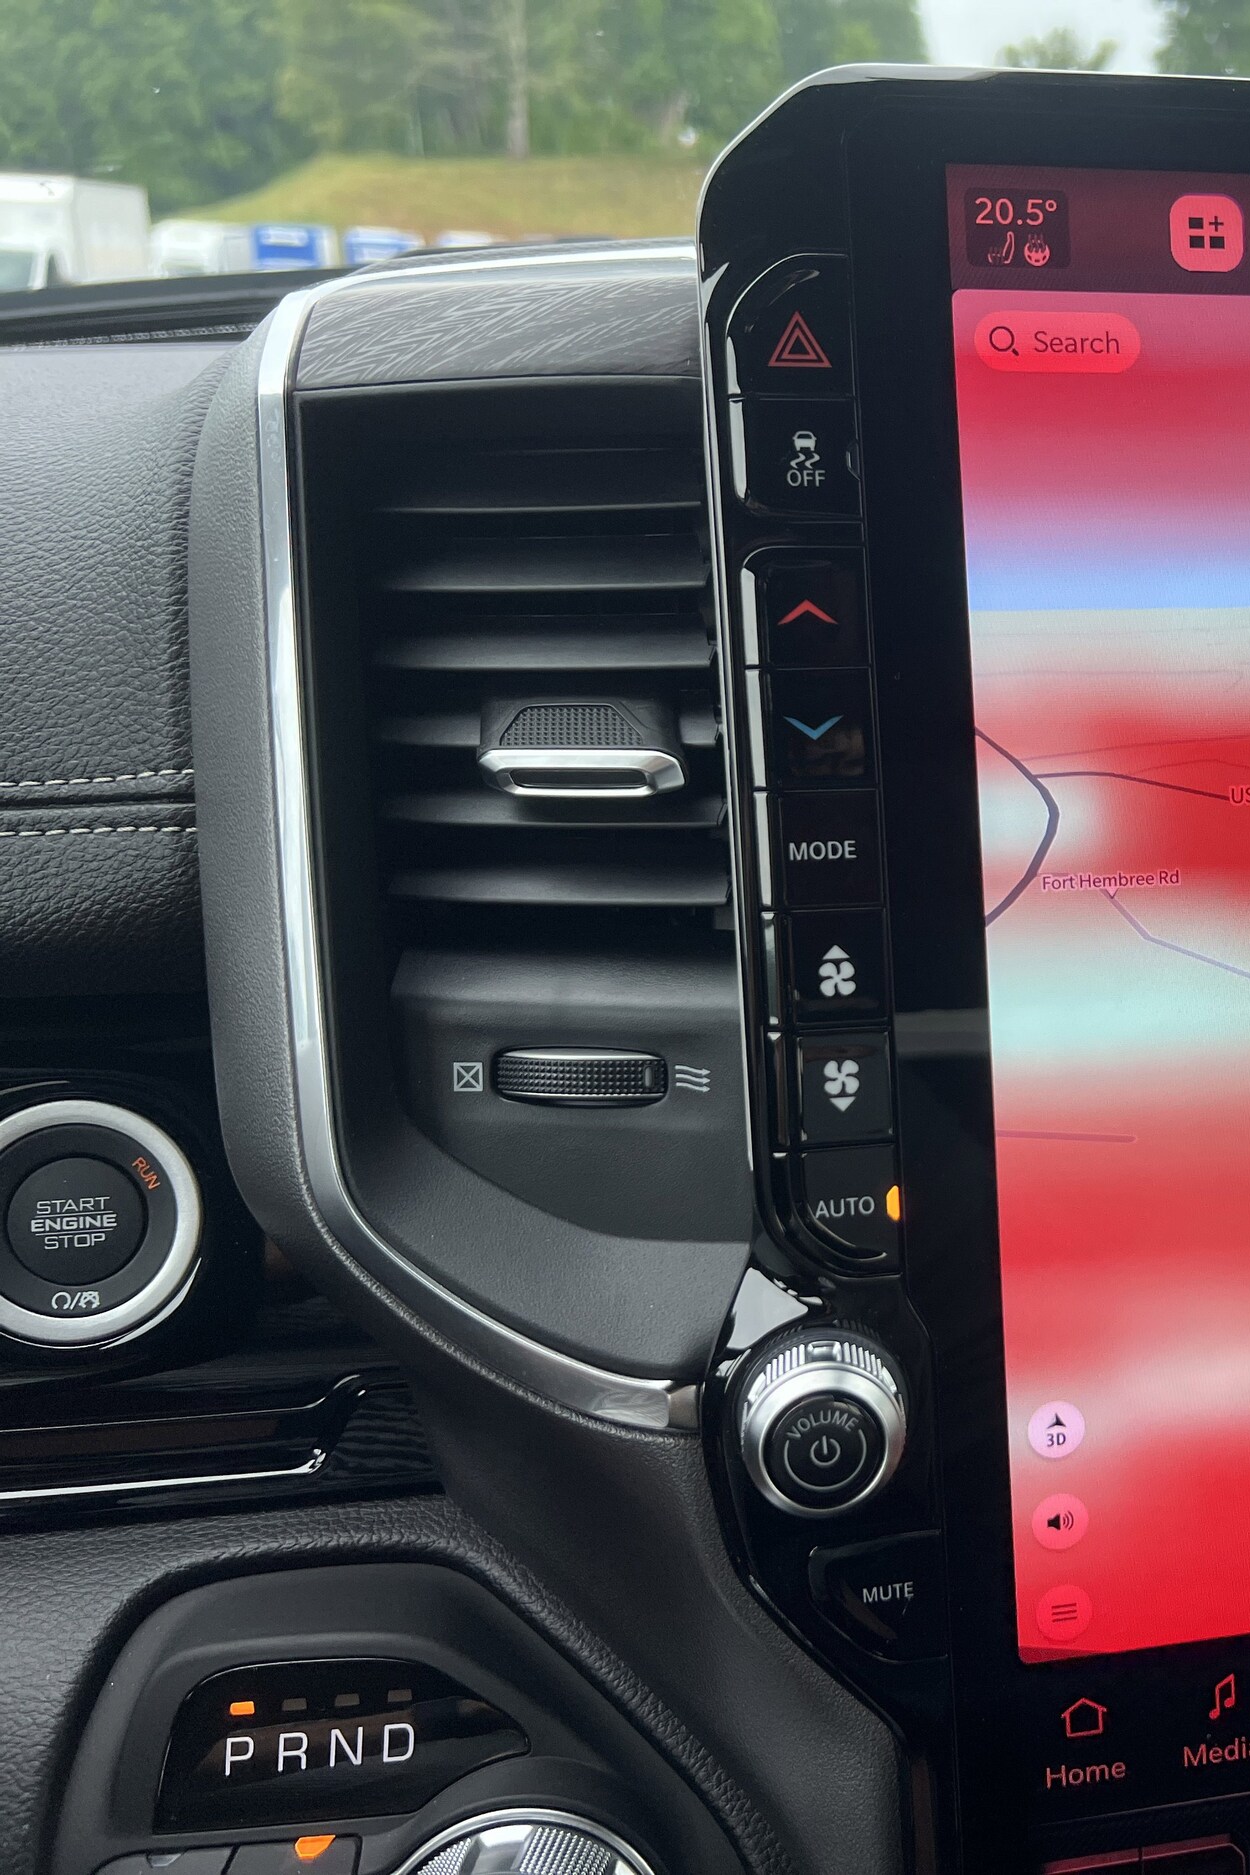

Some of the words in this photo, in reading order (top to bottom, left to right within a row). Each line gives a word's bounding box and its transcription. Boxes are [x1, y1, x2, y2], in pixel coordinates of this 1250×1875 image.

[975, 197, 1057, 226] 20.5°
[1033, 330, 1120, 355] Search
[786, 470, 826, 487] OFF
[789, 840, 857, 861] MODE
[1042, 875, 1075, 890] Fort
[1079, 872, 1155, 888] Hembree
[1161, 870, 1180, 886] Rd
[131, 1156, 161, 1190] RUN
[36, 1196, 110, 1215] START
[815, 1196, 875, 1219] AUTO
[30, 1213, 117, 1233] ENGINE
[44, 1232, 106, 1250] STOP
[785, 1409, 859, 1439] VOLUME
[1046, 1432, 1066, 1448] 3D
[862, 1581, 914, 1603] MUTE
[1046, 1759, 1126, 1789] Home
